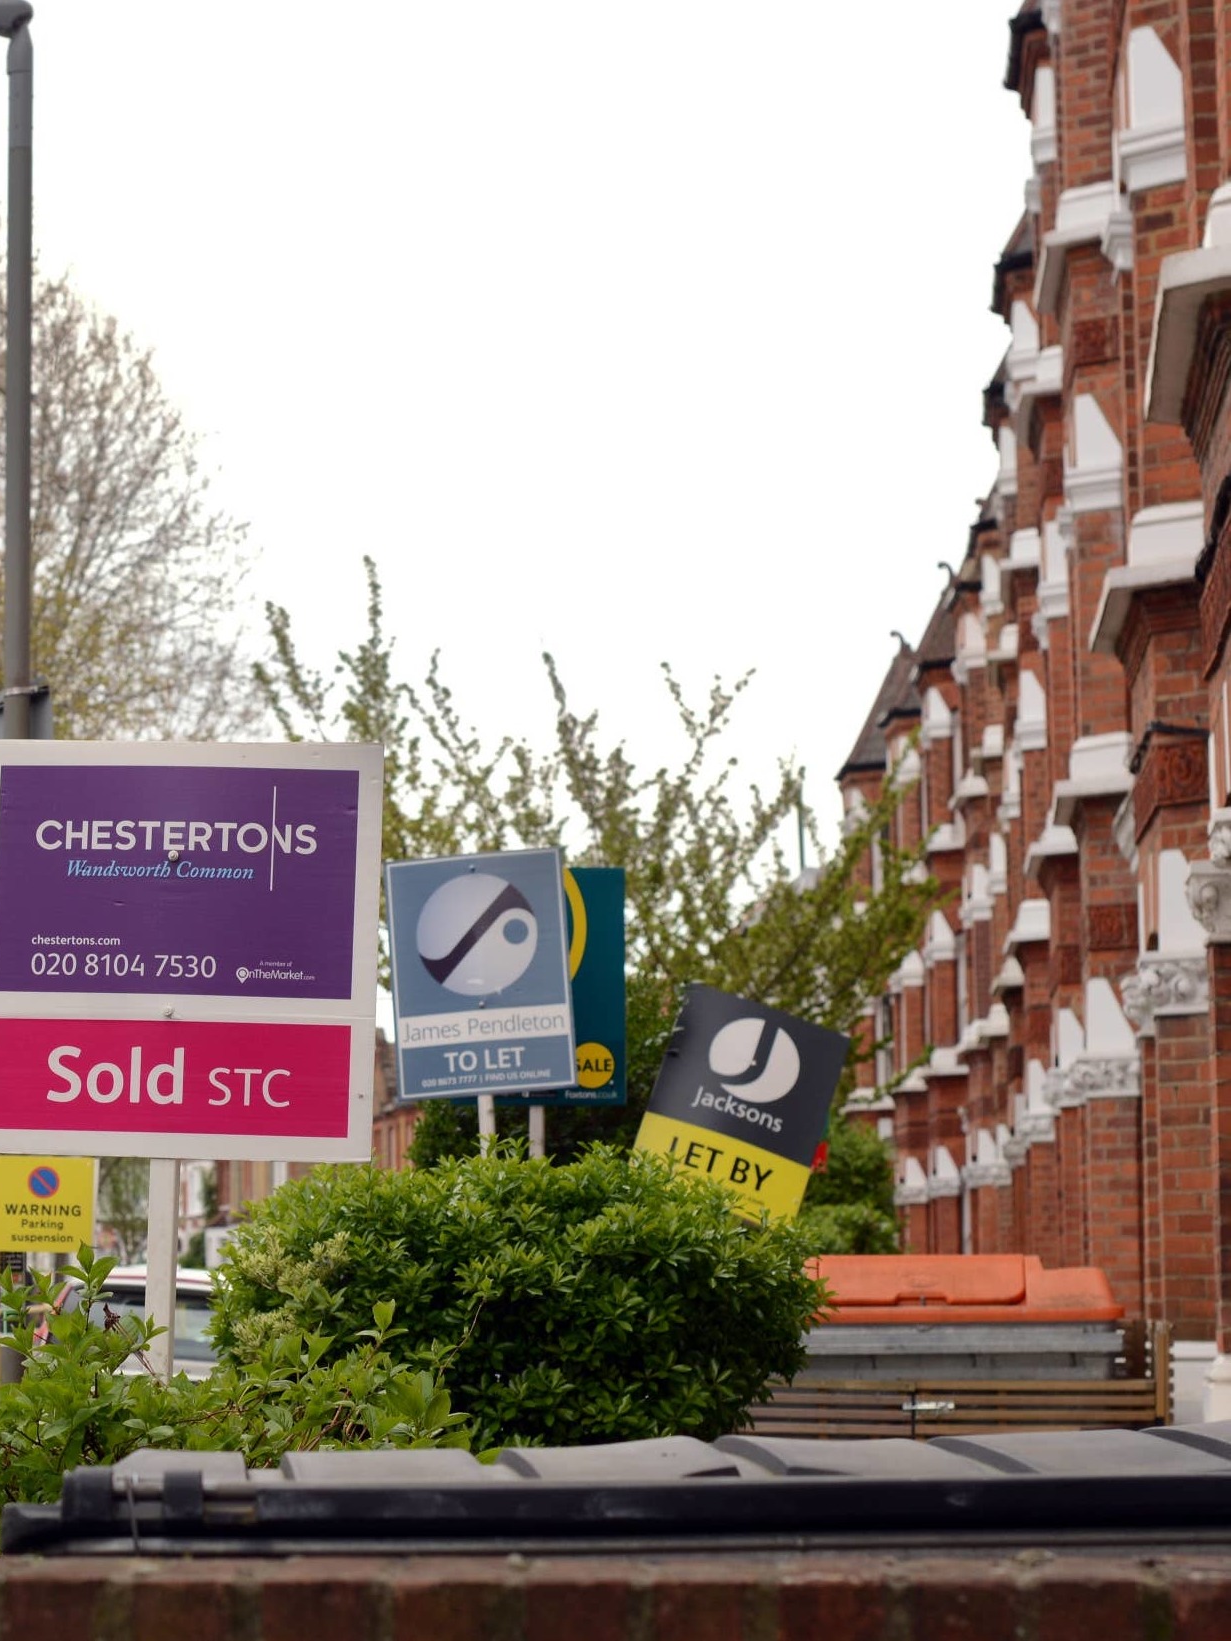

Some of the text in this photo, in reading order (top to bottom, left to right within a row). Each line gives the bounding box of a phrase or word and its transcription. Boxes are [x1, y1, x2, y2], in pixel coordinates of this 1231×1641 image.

[35, 820, 318, 855] CHESTERTONS
[67, 859, 255, 880] Wandsworth Common
[31, 934, 121, 947] chestertons.com
[31, 953, 217, 978] 020 8104 7530
[403, 1014, 565, 1043] James Pendleton
[444, 1046, 526, 1073] TO LET
[46, 1045, 291, 1108] Sold STC
[691, 1086, 784, 1133] Jacksons
[730, 1157, 774, 1192] BY
[5, 1204, 81, 1216] WARNING
[11, 1232, 74, 1243] suspension
[21, 1218, 64, 1231] Parking
